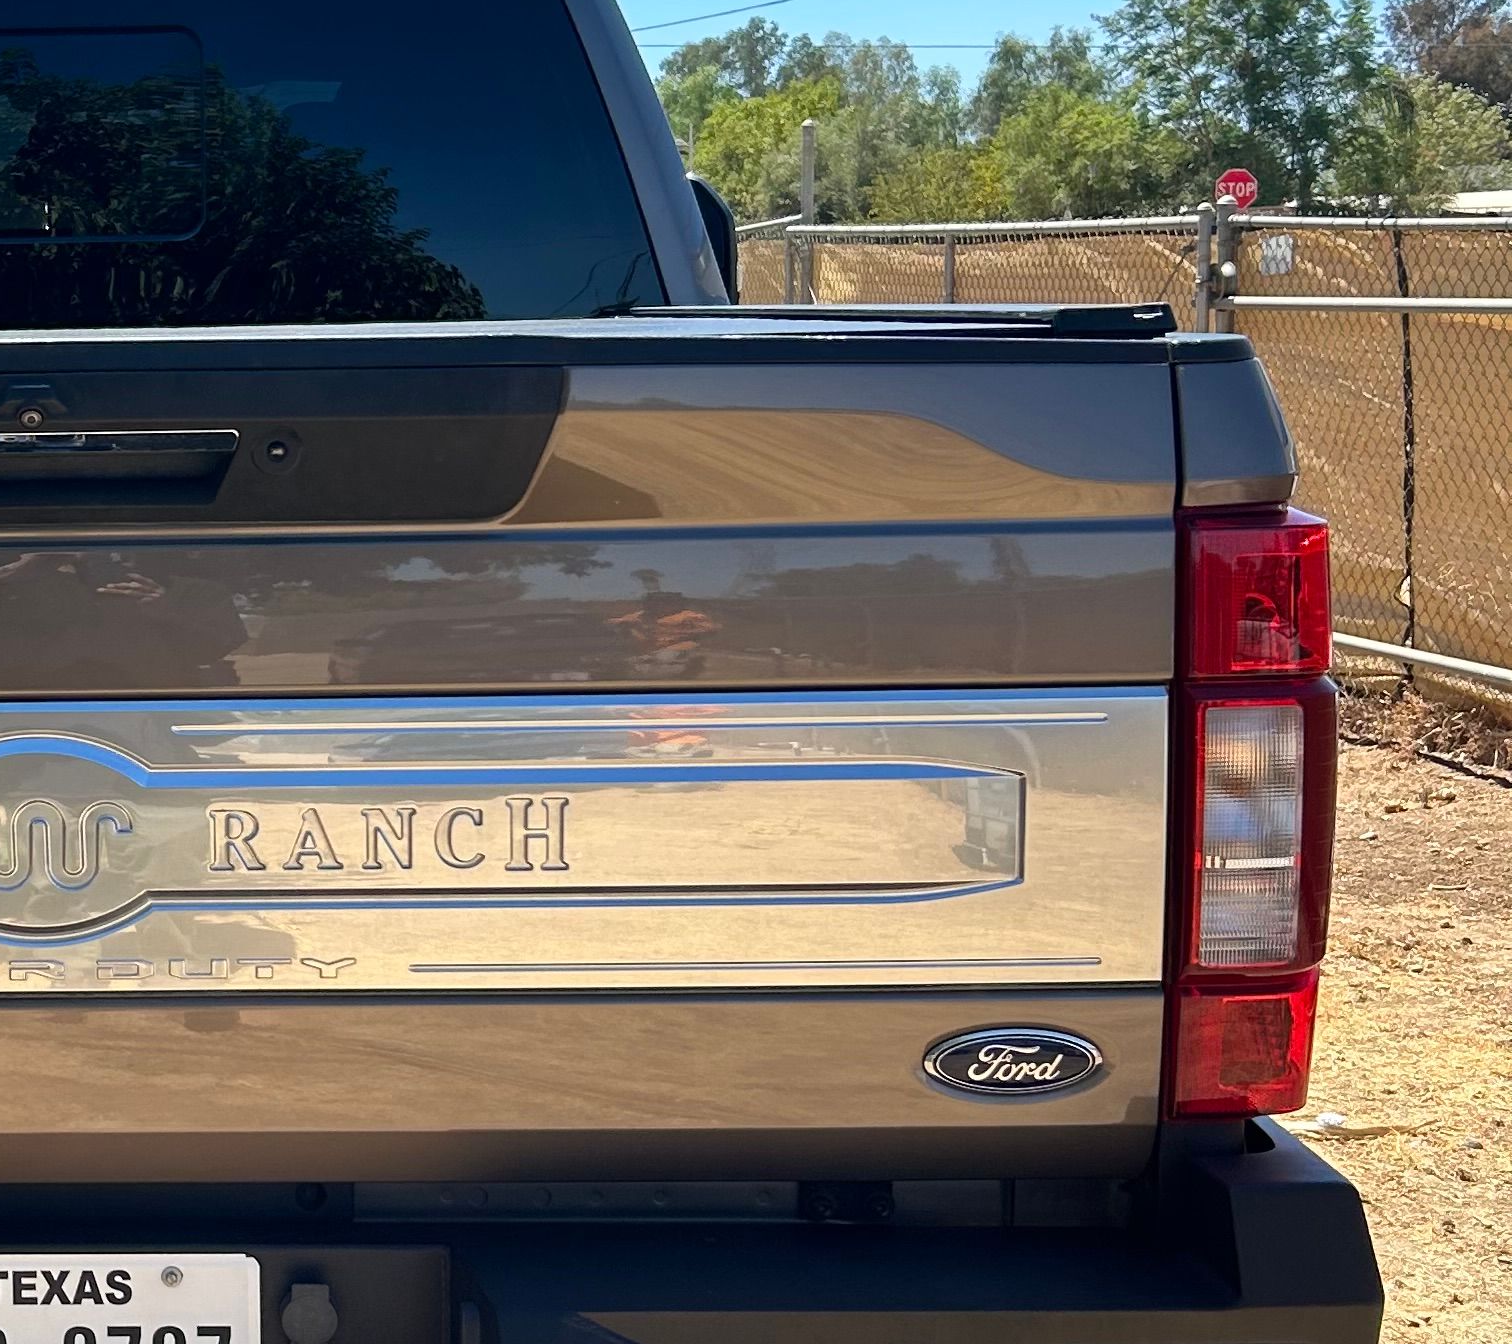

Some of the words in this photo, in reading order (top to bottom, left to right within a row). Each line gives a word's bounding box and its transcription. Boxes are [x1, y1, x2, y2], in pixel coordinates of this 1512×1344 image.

[1217, 181, 1256, 198] STOP
[208, 797, 570, 872] RANCH
[95, 956, 357, 981] DUTY
[967, 1043, 1064, 1081] Ford
